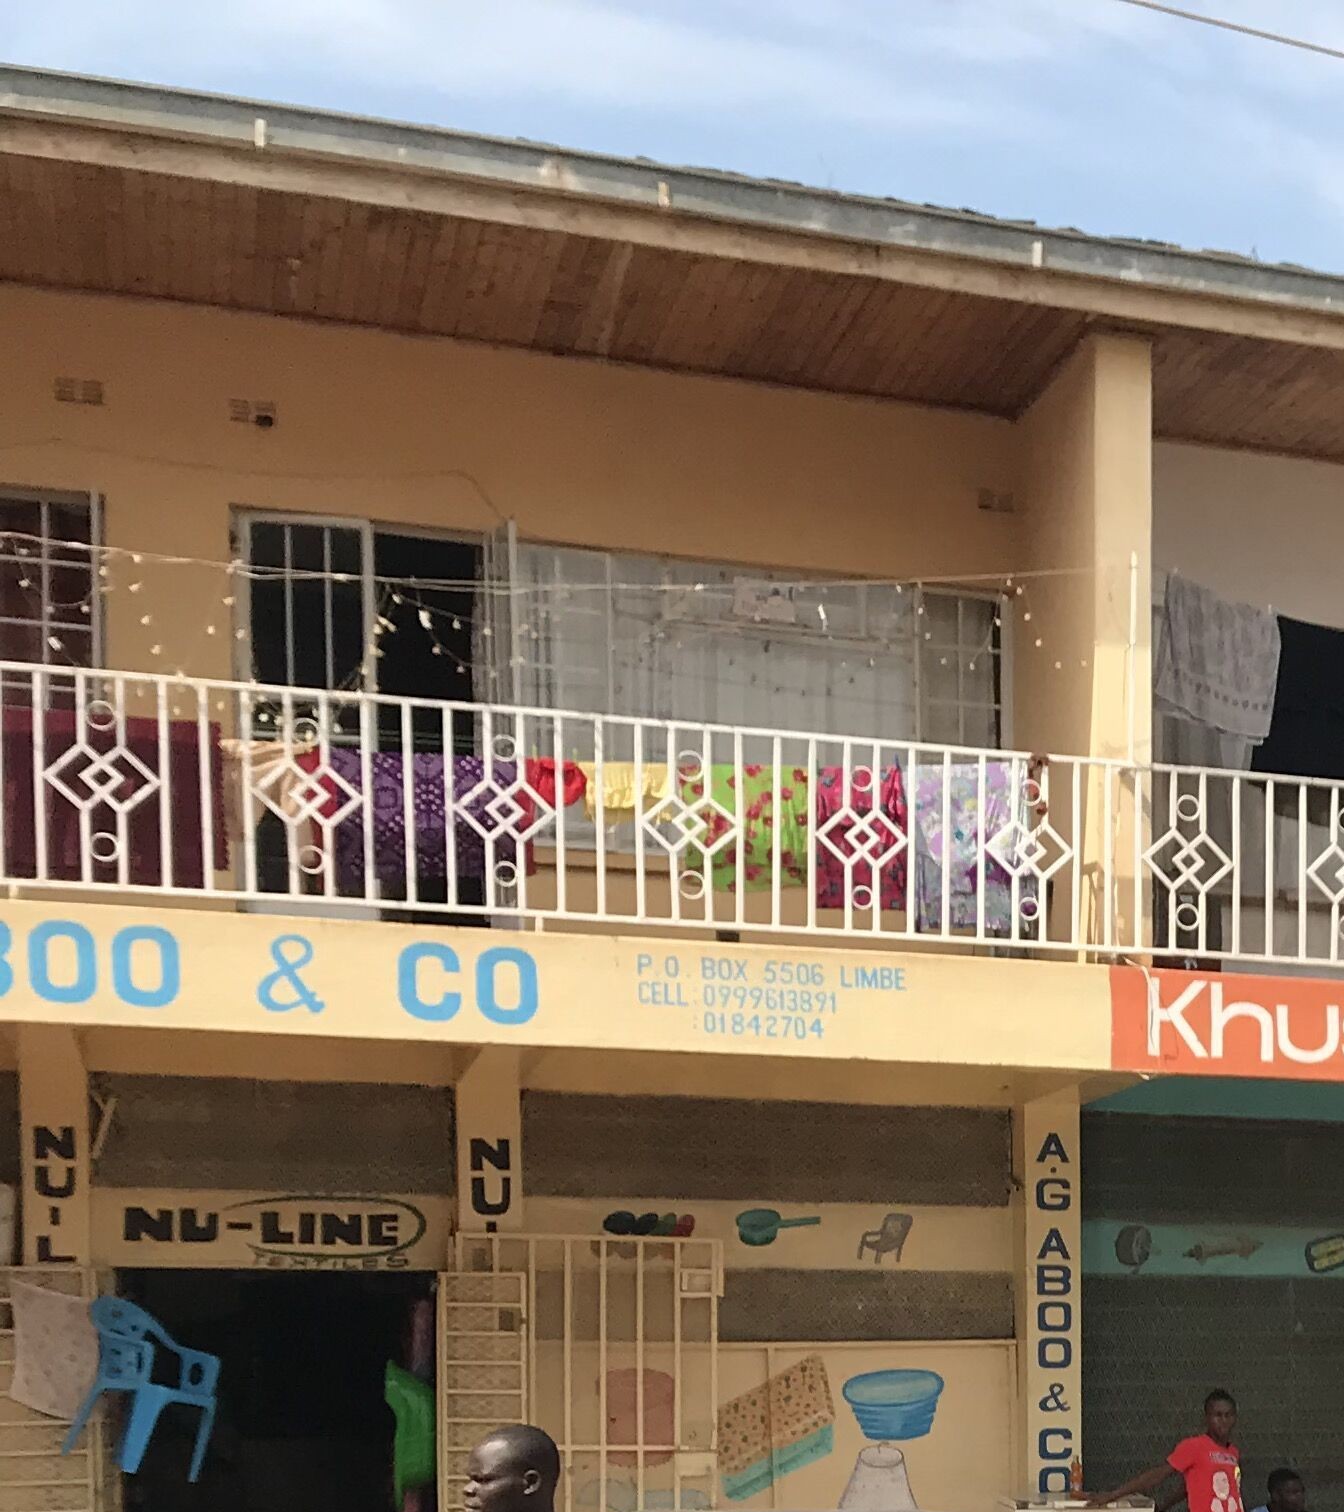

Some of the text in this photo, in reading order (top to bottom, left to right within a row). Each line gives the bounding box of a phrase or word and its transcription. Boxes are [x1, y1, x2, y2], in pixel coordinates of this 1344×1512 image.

[0, 919, 538, 1026] OO & CO
[701, 956, 748, 982] BOX
[764, 960, 824, 986] 5506
[840, 965, 906, 991] LIMBE
[123, 1206, 400, 1248] NU-LINE
